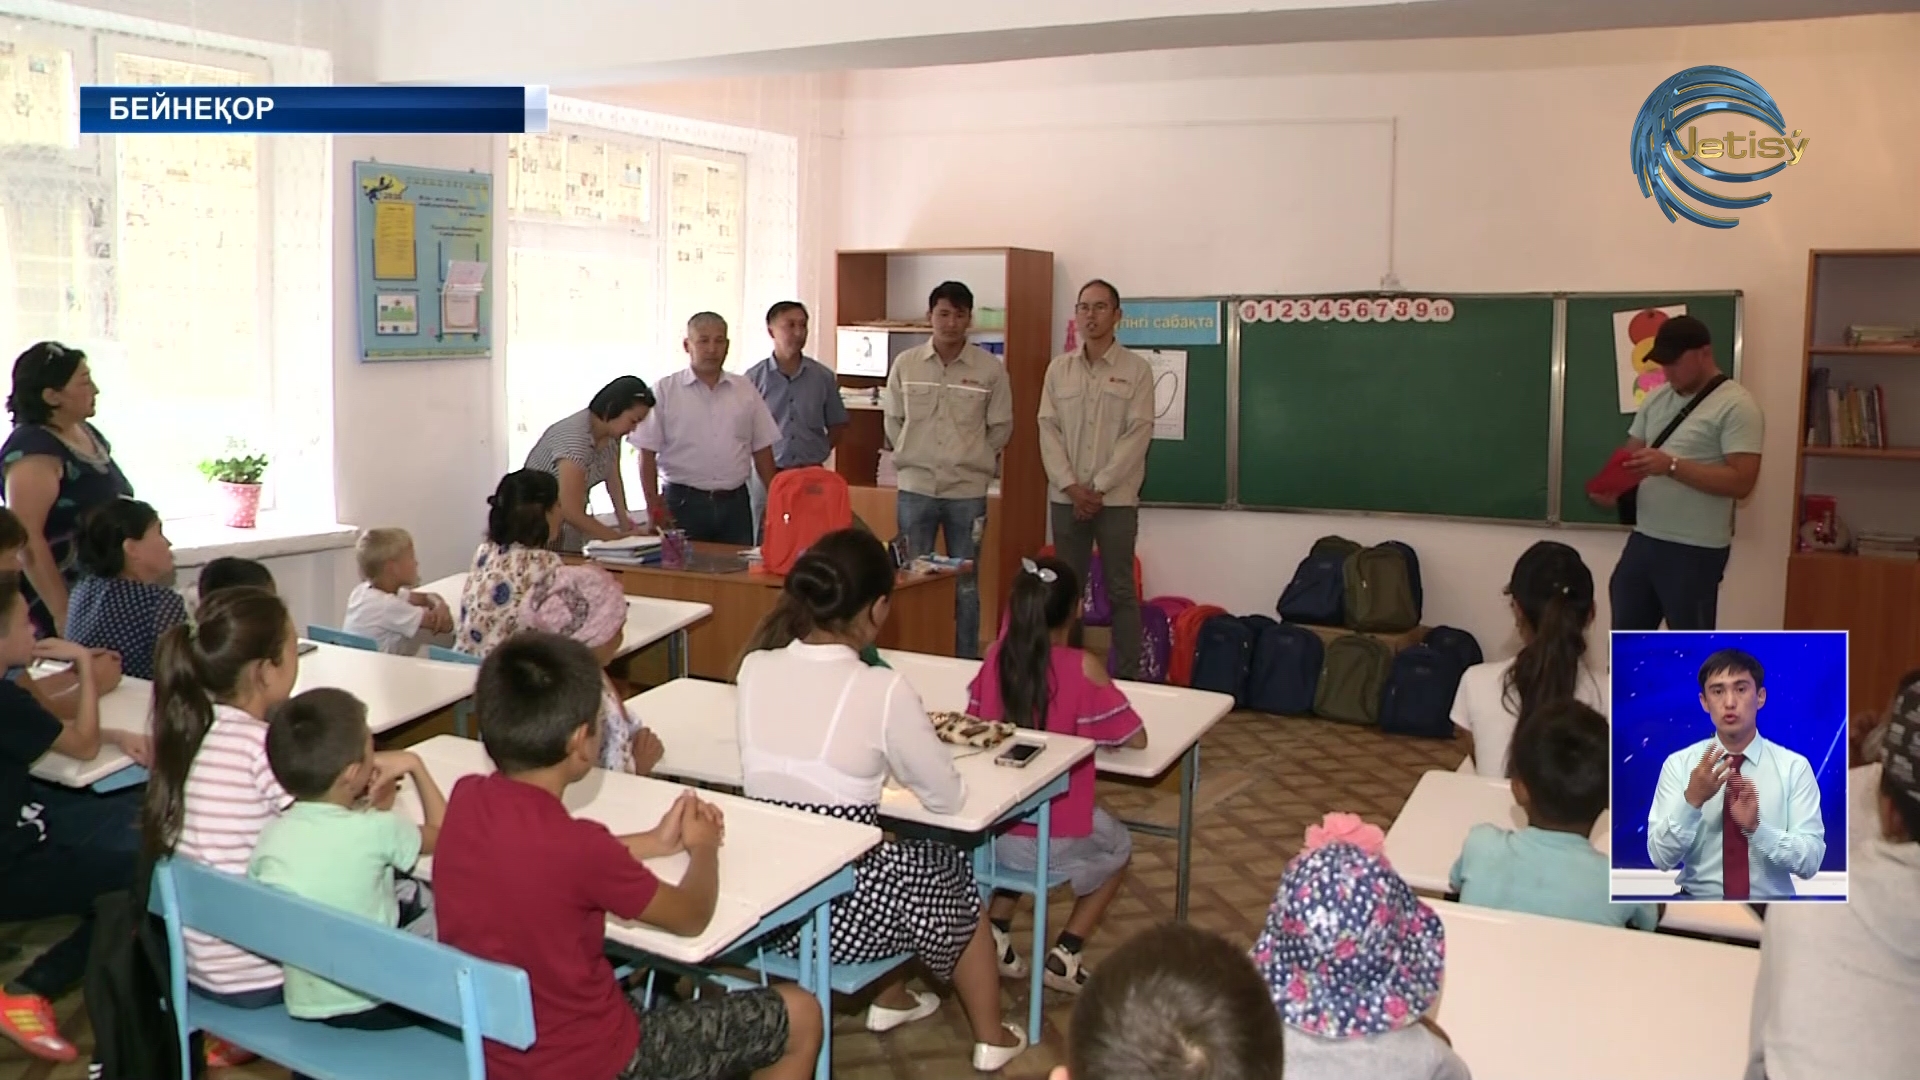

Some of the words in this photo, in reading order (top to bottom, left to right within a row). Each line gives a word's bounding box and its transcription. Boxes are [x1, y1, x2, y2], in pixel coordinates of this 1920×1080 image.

[1264, 303, 1273, 318] 1
[1281, 303, 1293, 318] 2
[1300, 302, 1311, 317] 3
[1319, 301, 1331, 316] 4
[1338, 302, 1350, 317] 5
[1356, 302, 1368, 317] 6
[1376, 303, 1388, 317] 7
[1416, 302, 1429, 317] 9
[1434, 306, 1449, 316] 10
